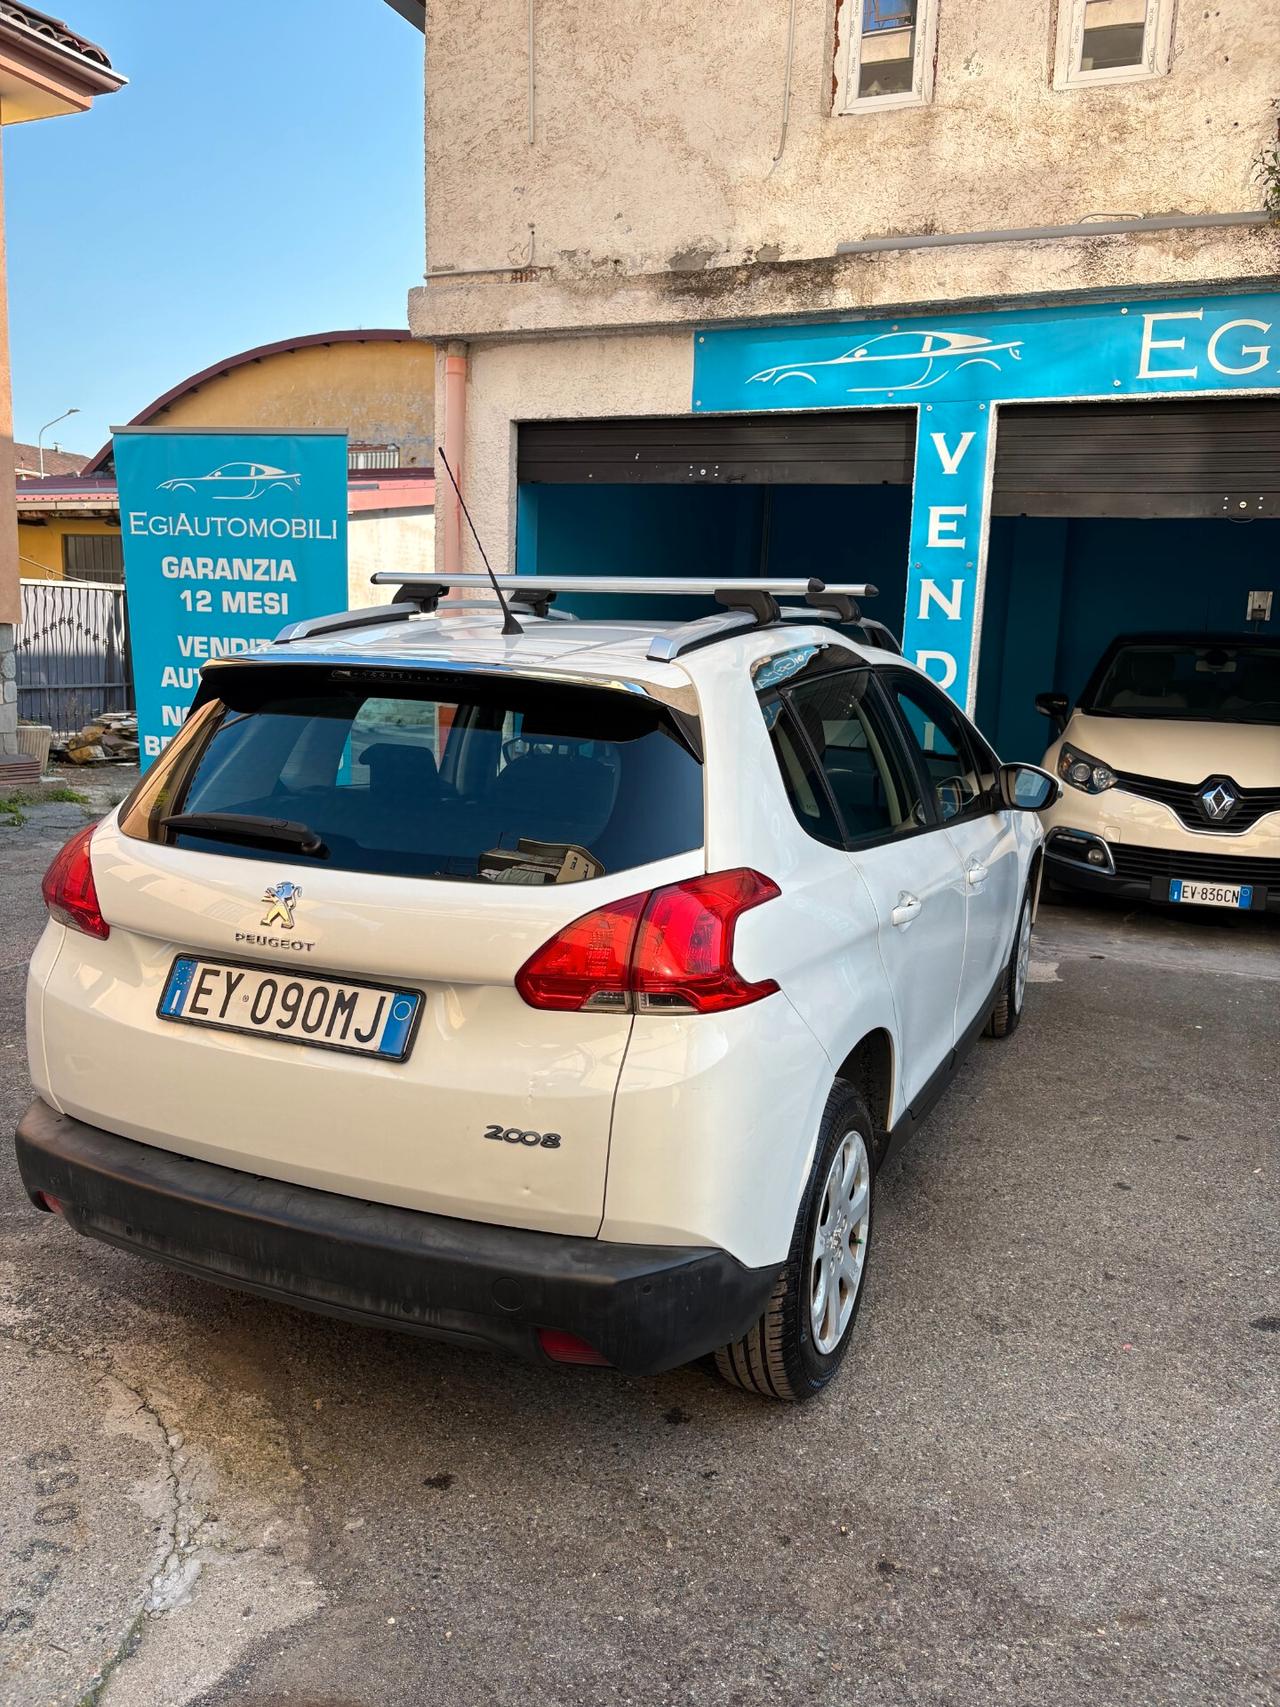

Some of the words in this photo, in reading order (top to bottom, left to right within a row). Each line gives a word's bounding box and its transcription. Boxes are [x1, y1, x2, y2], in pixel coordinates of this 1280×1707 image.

[1136, 307, 1280, 379] EG
[161, 556, 298, 582] GARANZIA
[179, 589, 213, 612] 12
[221, 591, 289, 615] MESI
[235, 932, 315, 951] PEUGEOT
[484, 1125, 561, 1148] 2008
